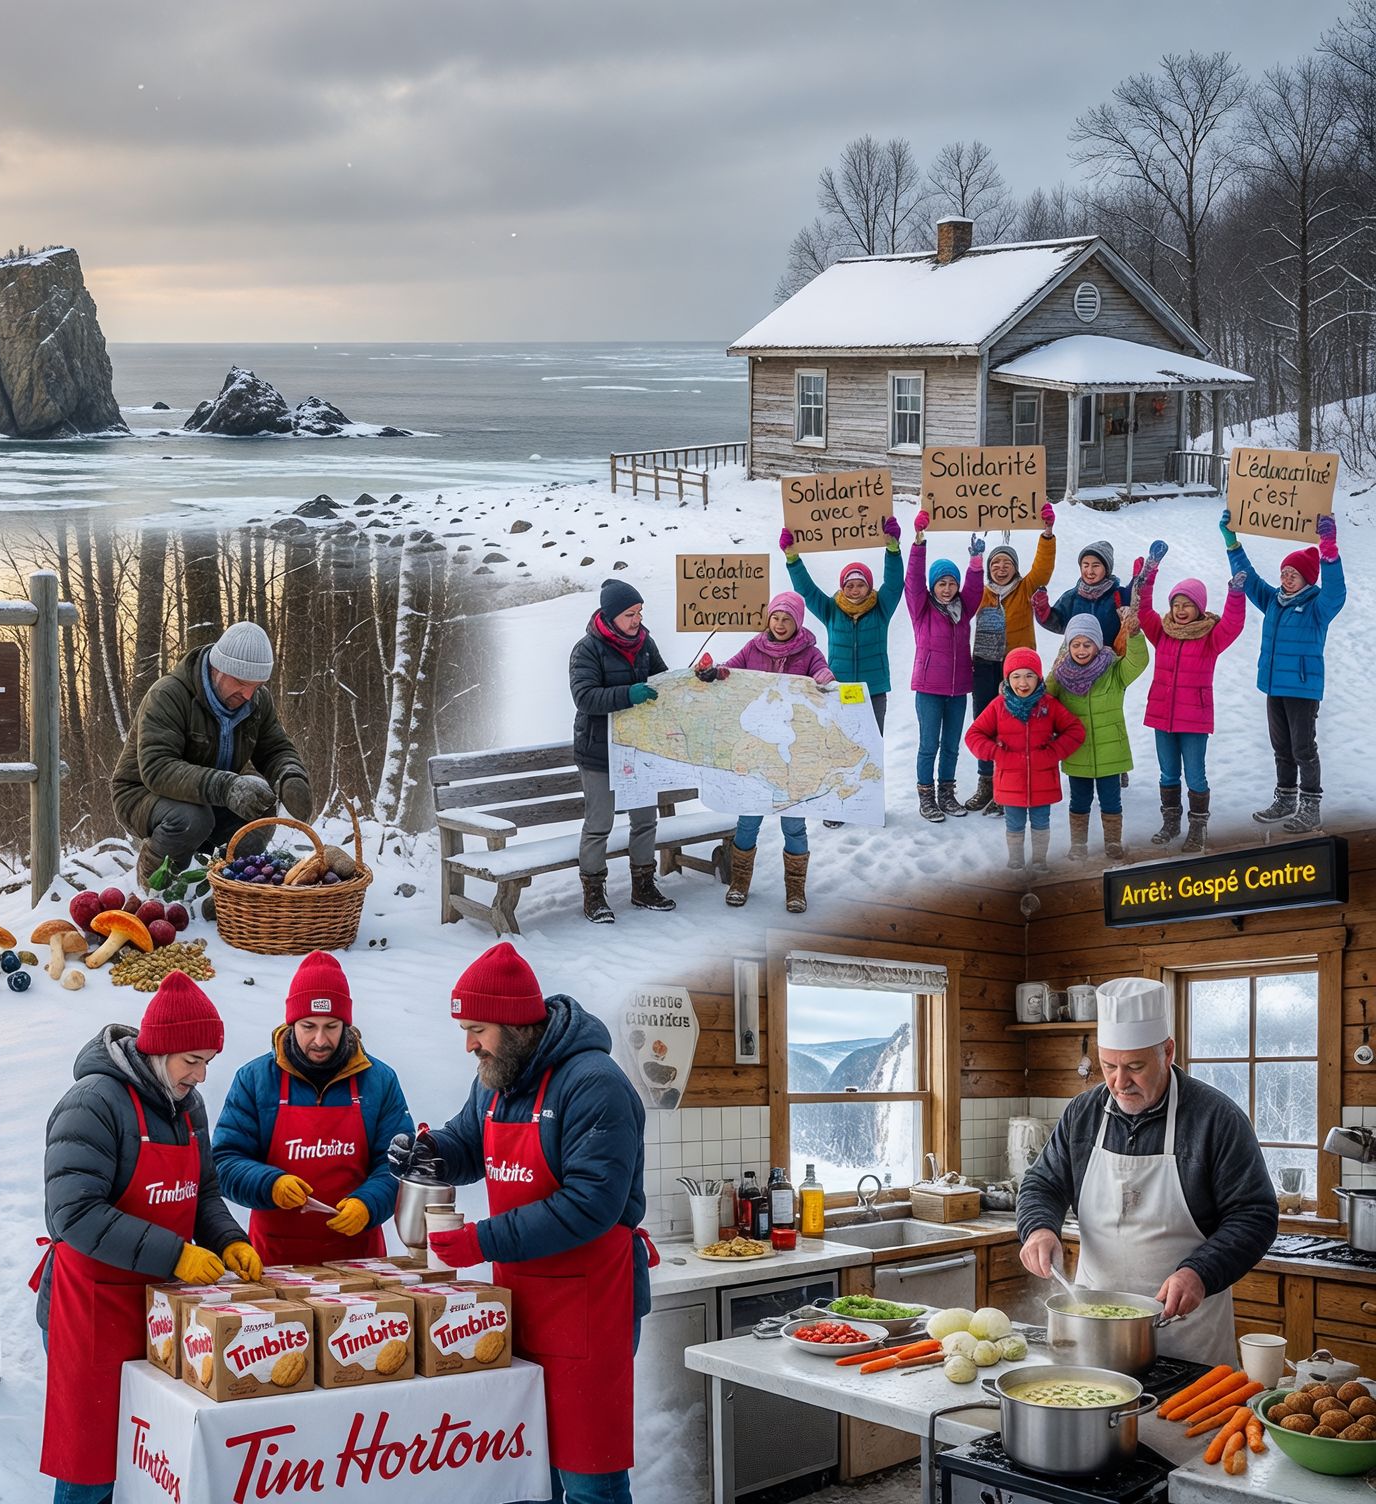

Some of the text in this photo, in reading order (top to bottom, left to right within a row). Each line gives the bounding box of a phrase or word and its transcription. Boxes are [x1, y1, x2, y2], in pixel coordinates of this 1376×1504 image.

[930, 451, 1036, 477] Solidarité
[789, 473, 884, 504] Solidarité
[955, 483, 1002, 497] avec
[1253, 484, 1298, 507] c'est
[810, 506, 853, 521] avec
[794, 528, 823, 543] nos
[699, 581, 739, 600] c'est
[1120, 882, 1173, 906] Arrêt:
[1244, 863, 1316, 889] Centre
[331, 1320, 409, 1359] Timbits
[433, 1308, 506, 1349] Timbits
[226, 1329, 308, 1372] Timbits
[226, 1424, 324, 1504] Tim
